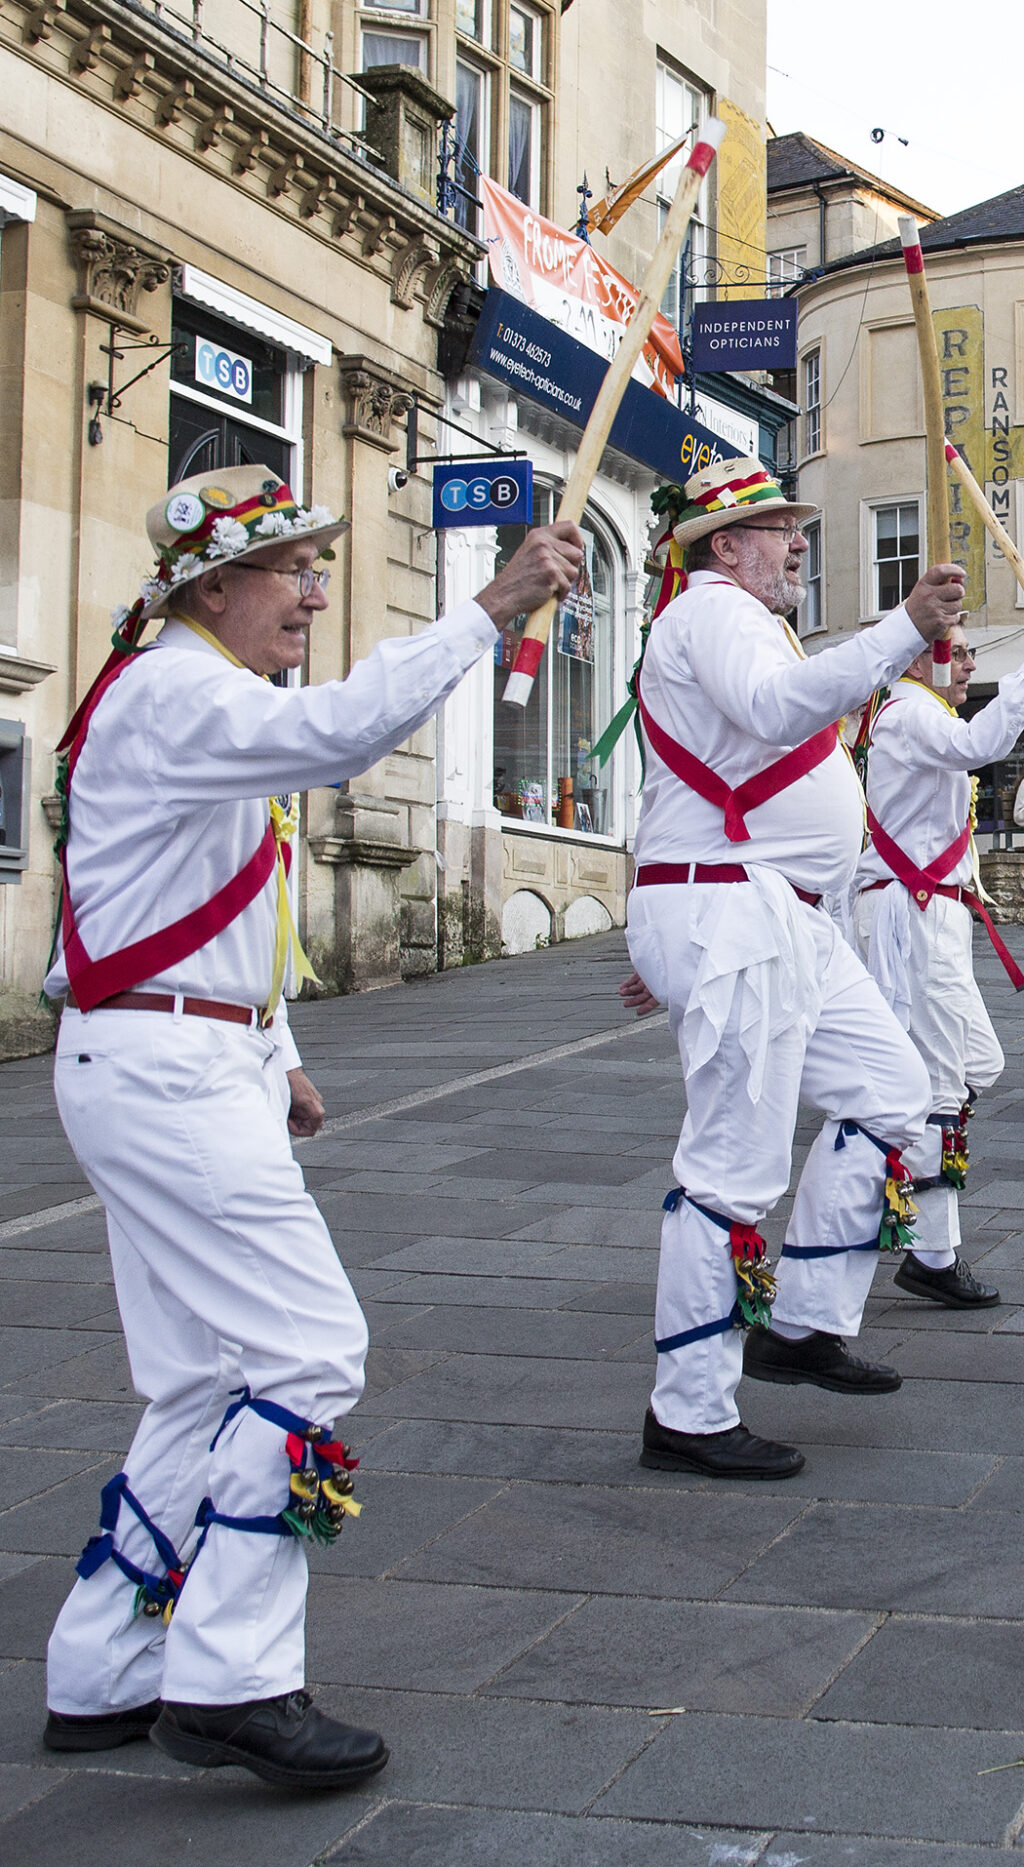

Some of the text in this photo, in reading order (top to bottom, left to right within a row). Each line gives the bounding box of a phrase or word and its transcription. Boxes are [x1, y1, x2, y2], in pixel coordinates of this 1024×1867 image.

[522, 212, 579, 289] FROME
[699, 319, 792, 334] INDEPENDENT
[709, 336, 781, 350] OPTICIANS
[503, 327, 527, 352] 01373
[525, 341, 552, 368] 462573
[200, 347, 249, 393] TSB
[489, 347, 582, 412] www.eyetech-opticians.co.uk
[445, 480, 516, 508] TSB
